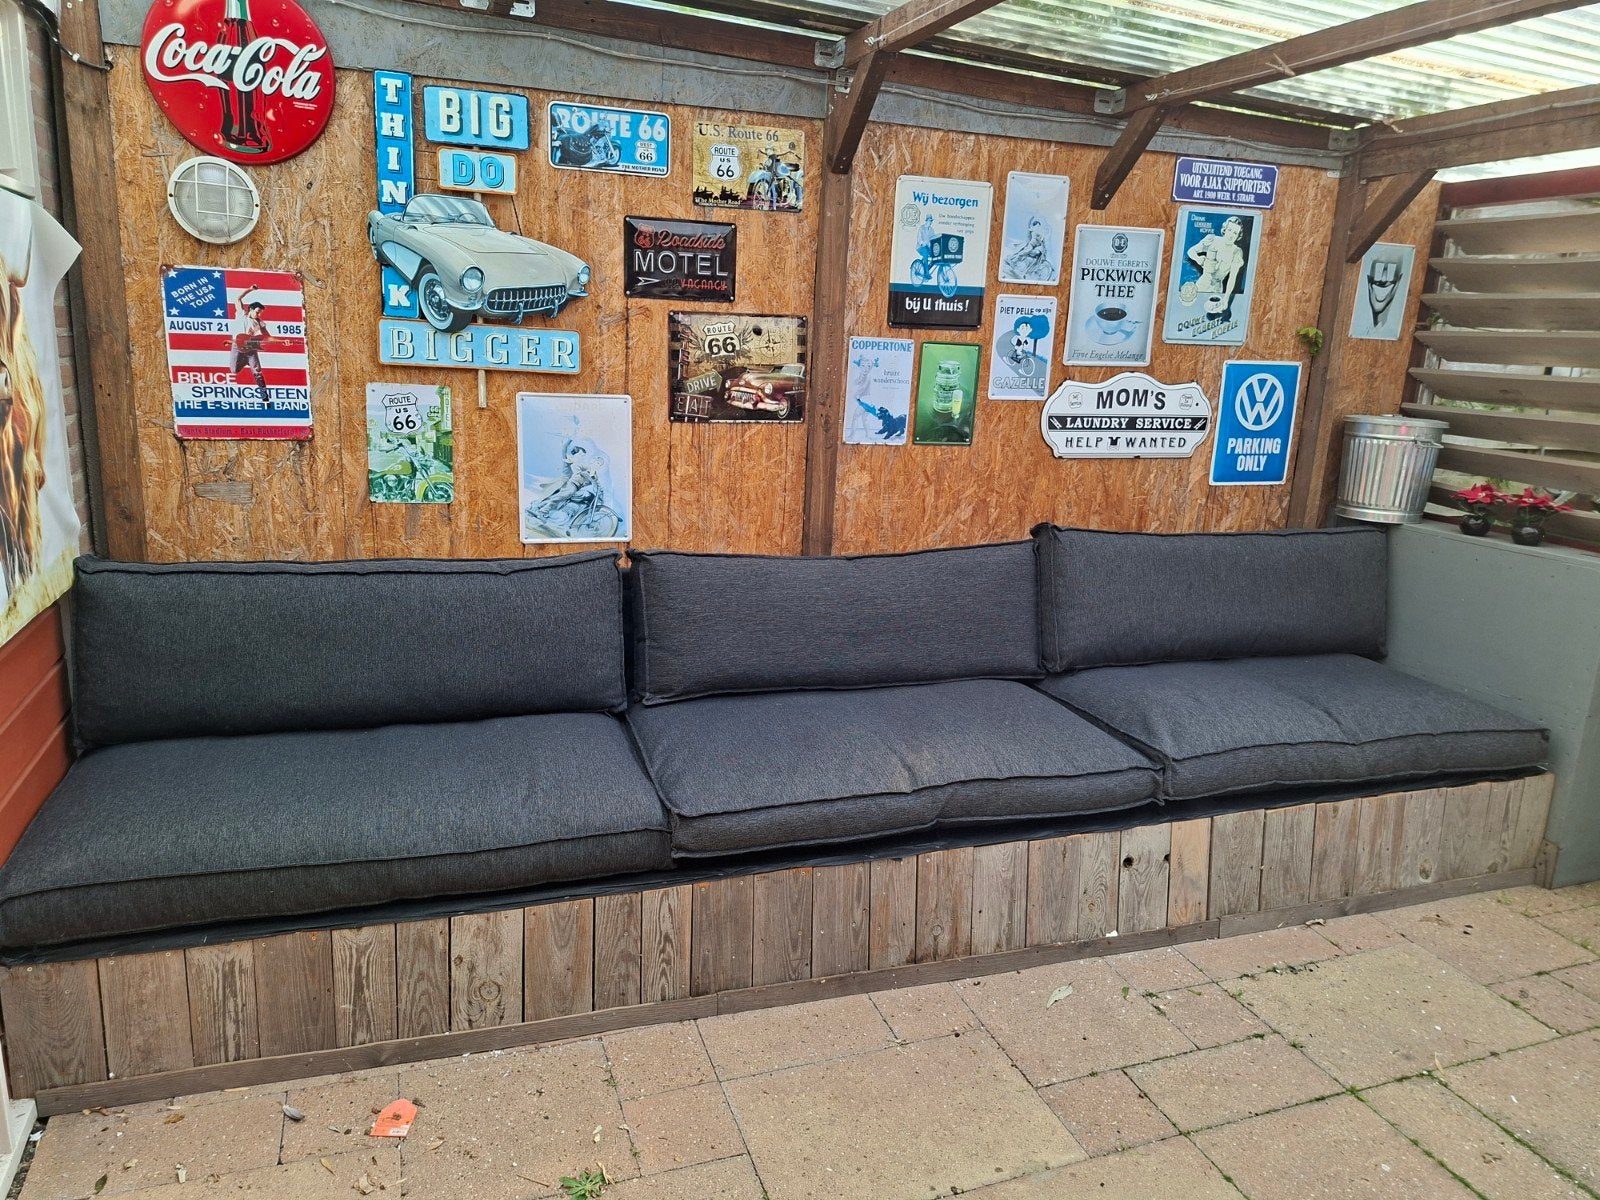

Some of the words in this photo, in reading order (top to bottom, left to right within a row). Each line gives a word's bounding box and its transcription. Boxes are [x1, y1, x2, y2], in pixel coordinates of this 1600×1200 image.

[145, 23, 327, 100] Coca-Cola
[438, 90, 511, 138] BIG
[557, 108, 631, 138] ROUTE
[638, 115, 666, 142] 66
[697, 123, 724, 136] U.S.
[728, 126, 763, 140] Route
[766, 130, 779, 141] 66
[639, 152, 653, 161] 66
[714, 146, 736, 156] ROUTE
[453, 153, 505, 188] DO
[716, 165, 735, 178] 66
[1192, 162, 1232, 176] UITSLUITEND
[1234, 166, 1263, 179] TOEGANG
[1180, 174, 1201, 188] VOOR
[1202, 176, 1223, 191] AJAX
[1223, 178, 1271, 194] SUPPORTERS
[912, 191, 929, 206] Wij
[931, 194, 979, 209] bezorgen
[656, 229, 726, 249] Roadside
[633, 249, 729, 277] MOTEL
[1086, 258, 1115, 267] DOUWE
[1118, 260, 1150, 268] EGBERTS
[681, 278, 728, 291] VACANCY
[1081, 268, 1152, 284] PICKWICK
[170, 281, 198, 298] BORN
[197, 276, 209, 286] IN
[176, 292, 197, 305] THE
[194, 284, 216, 296] USA
[1095, 284, 1136, 298] THEE
[190, 293, 216, 308] TOUR
[905, 297, 920, 314] bij
[923, 299, 931, 311] U
[1000, 306, 1015, 315] PIET
[1016, 307, 1034, 316] PELLE
[169, 320, 214, 332] AUGUST
[217, 322, 229, 332] 21
[276, 324, 302, 335] 1985
[707, 325, 732, 334] ROUTE
[1178, 315, 1205, 332] DOUWE
[1192, 317, 1224, 337] EGBERTS
[1211, 320, 1239, 339] KOFFIE
[389, 327, 575, 369] BIGGER
[707, 337, 737, 355] 66
[852, 339, 912, 353] COPPERTONE
[1114, 351, 1145, 361] Melange
[177, 371, 238, 385] BRUCE
[686, 376, 717, 394] DRIVE
[992, 376, 1046, 390] GAZELLE
[191, 386, 308, 400] SPRINGSTEEN
[388, 395, 412, 404] ROUTE
[1096, 388, 1166, 410] MOM'S
[176, 401, 203, 410] THE
[207, 401, 270, 411] E-STREET
[274, 402, 309, 411] BAND
[677, 395, 709, 413] EAT
[393, 414, 417, 431] 66
[1066, 417, 1129, 429] LAUNDRY
[1135, 418, 1192, 429] SERVICE
[204, 427, 232, 436] Stadium
[240, 427, 256, 436] East
[1065, 437, 1103, 448] HELP
[1125, 436, 1187, 448] WANTED
[1227, 437, 1282, 455] PARKING
[1236, 455, 1268, 472] ONLY
